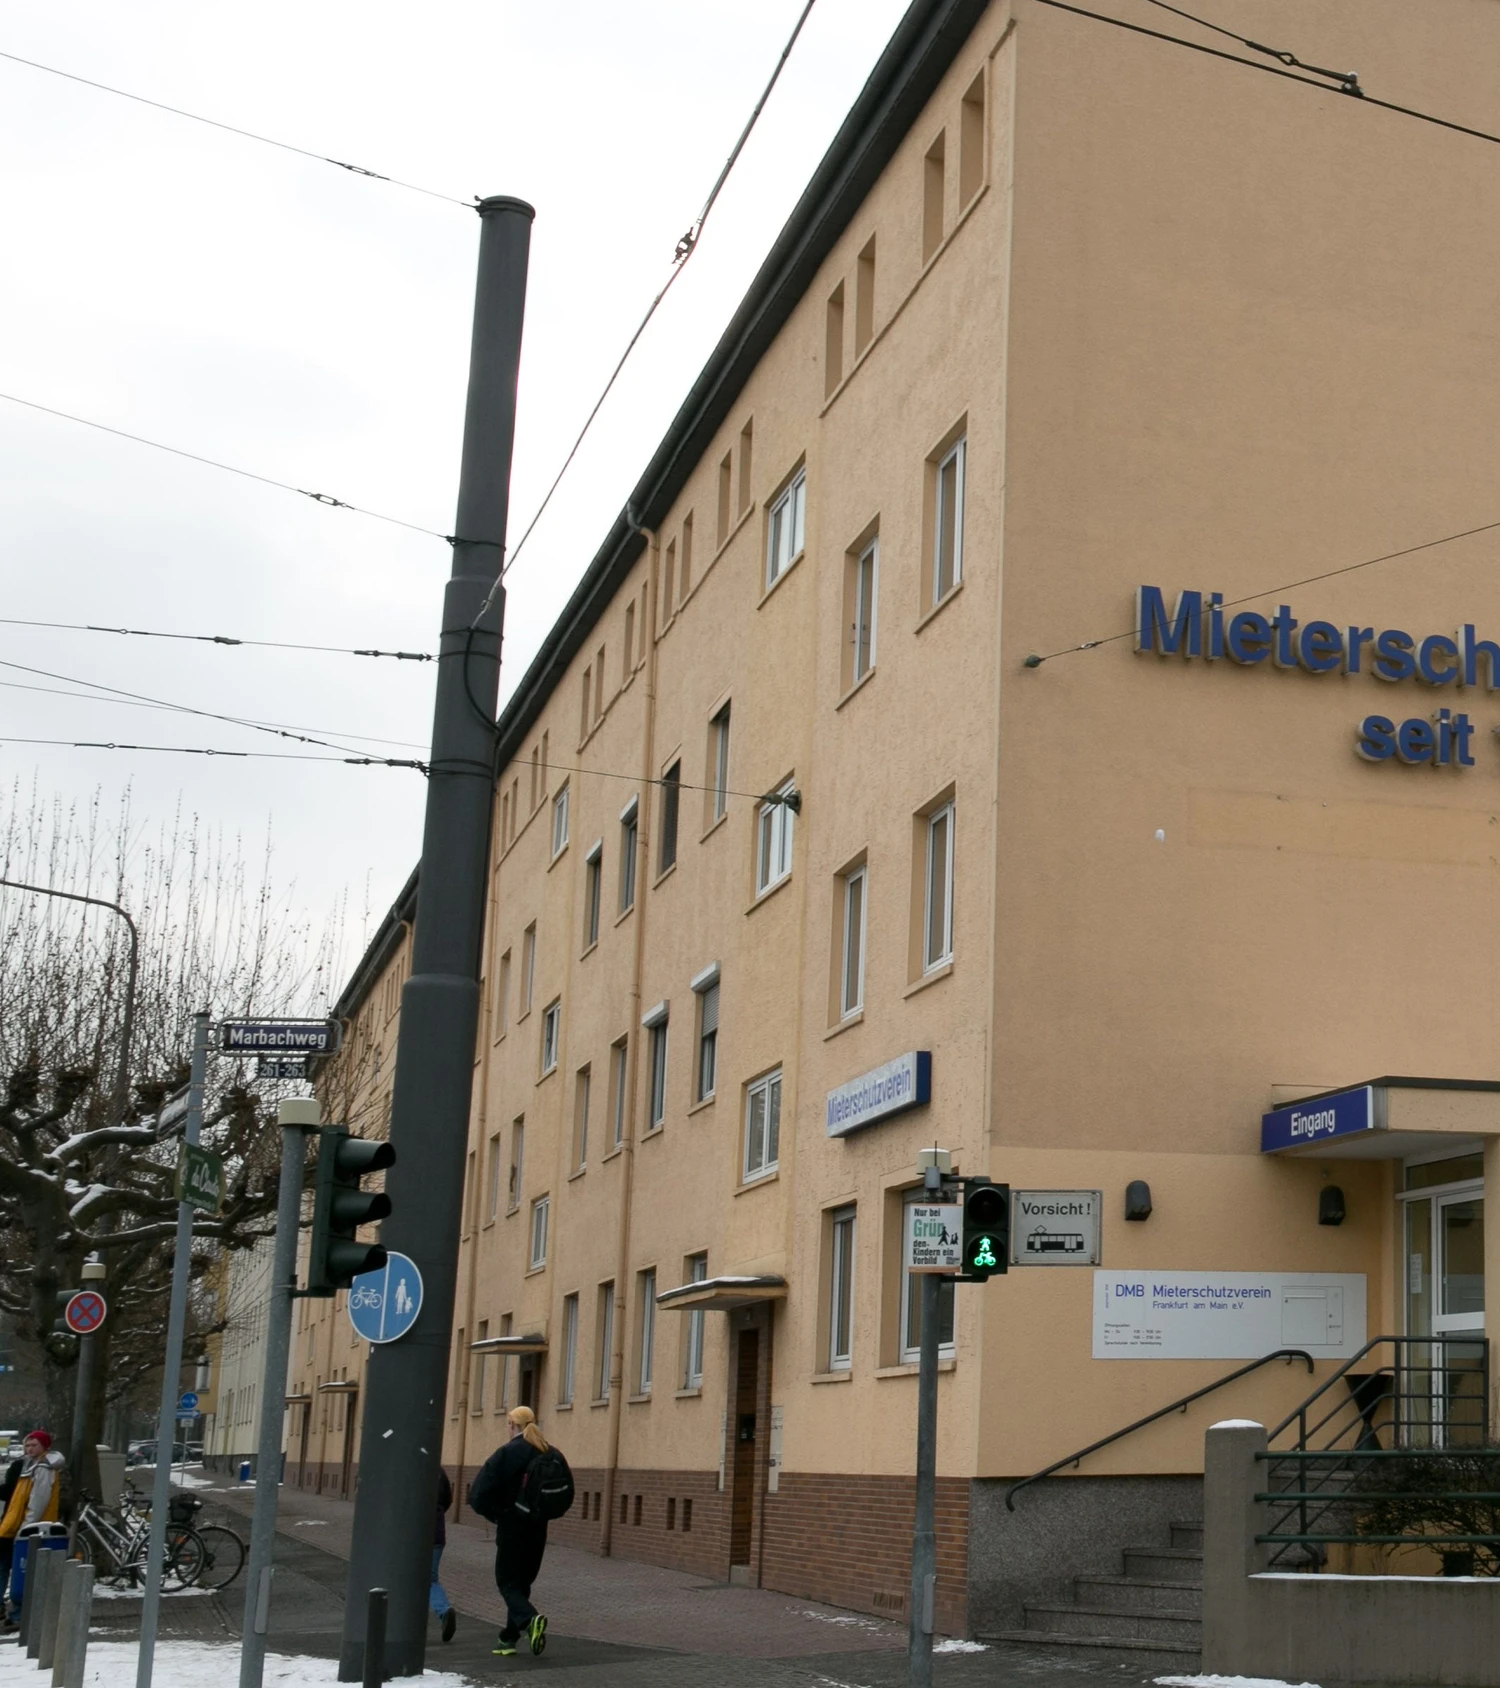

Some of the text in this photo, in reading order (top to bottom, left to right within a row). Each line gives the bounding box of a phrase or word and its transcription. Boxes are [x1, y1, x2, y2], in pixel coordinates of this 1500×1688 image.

[1357, 708, 1474, 767] seit
[230, 1028, 327, 1049] Marbachweg
[260, 1062, 306, 1078] 261-263
[827, 1064, 911, 1126] Mieterschutzverein
[1291, 1109, 1335, 1137] Eingang
[914, 1208, 941, 1217] Nur bei
[913, 1218, 945, 1238] Grün
[912, 1256, 938, 1265] Vorbild
[1116, 1284, 1145, 1298] DMB
[1152, 1284, 1271, 1298] Mieterschutzverein
[1152, 1300, 1189, 1310] Frankfurt
[1193, 1302, 1206, 1310] am
[1209, 1301, 1228, 1310] Main
